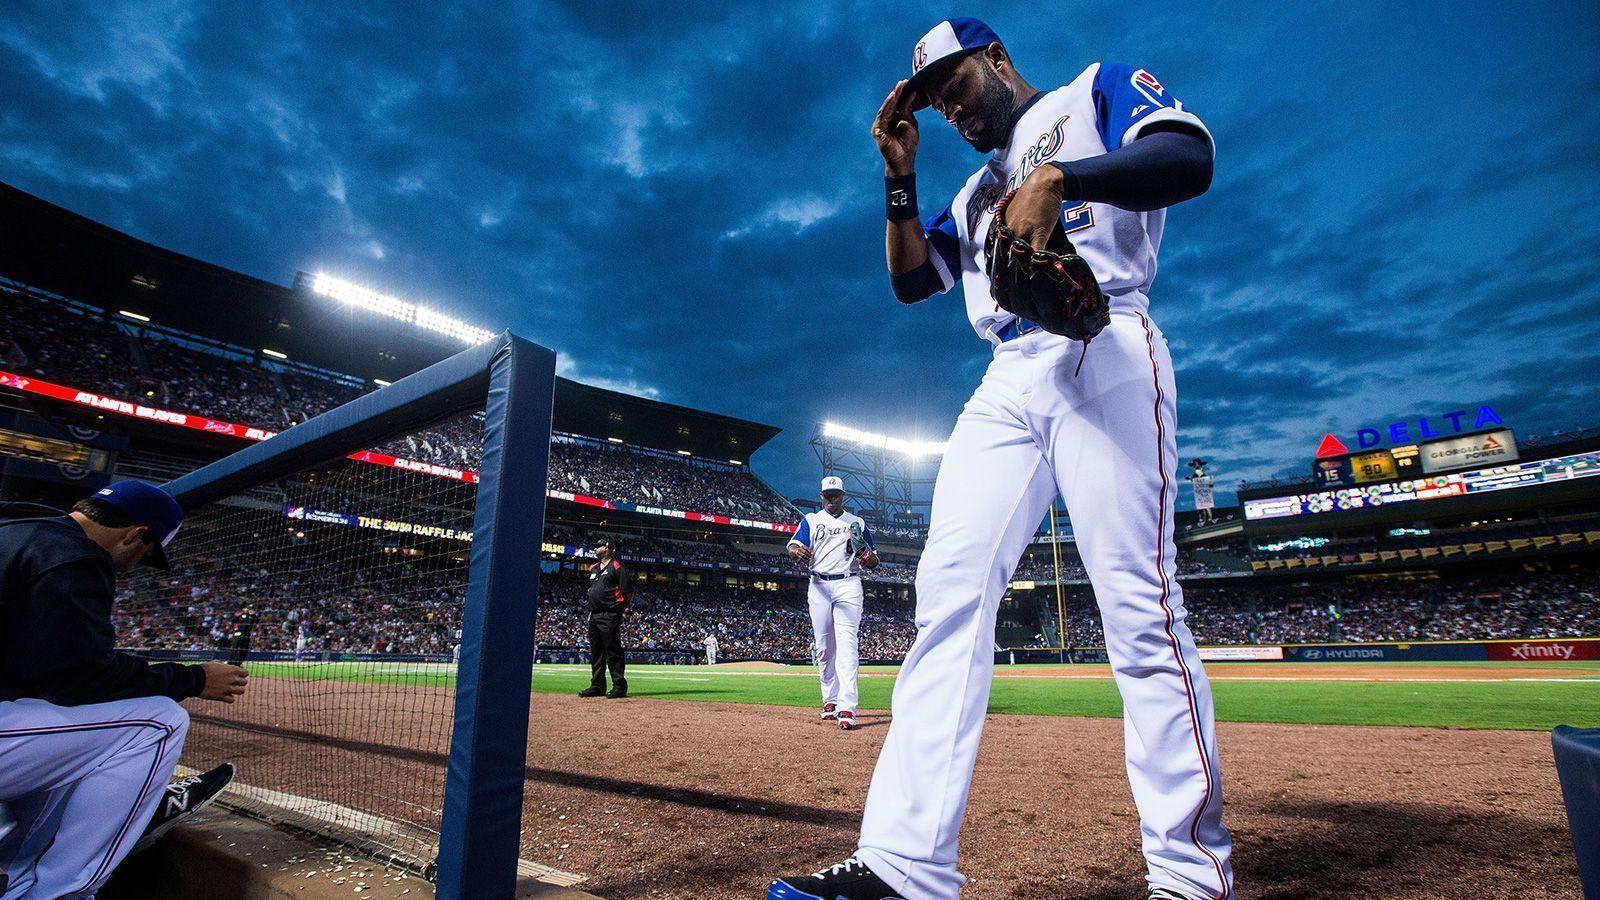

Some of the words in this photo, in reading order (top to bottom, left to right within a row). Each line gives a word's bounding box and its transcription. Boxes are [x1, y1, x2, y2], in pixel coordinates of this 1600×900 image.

[74, 392, 134, 415] ATLANTA
[135, 404, 187, 424] BRAVES
[1356, 405, 1503, 449] DELTA
[1430, 446, 1479, 459] GEORGIA
[1465, 448, 1506, 460] POWER
[636, 505, 662, 515] ATLANTA
[357, 516, 382, 529] THE
[413, 524, 457, 538] RAFFLE
[456, 530, 474, 542] JAC
[814, 523, 851, 541] Brav
[1326, 649, 1384, 658] HYUNDAI
[1510, 643, 1574, 659] xfinity
